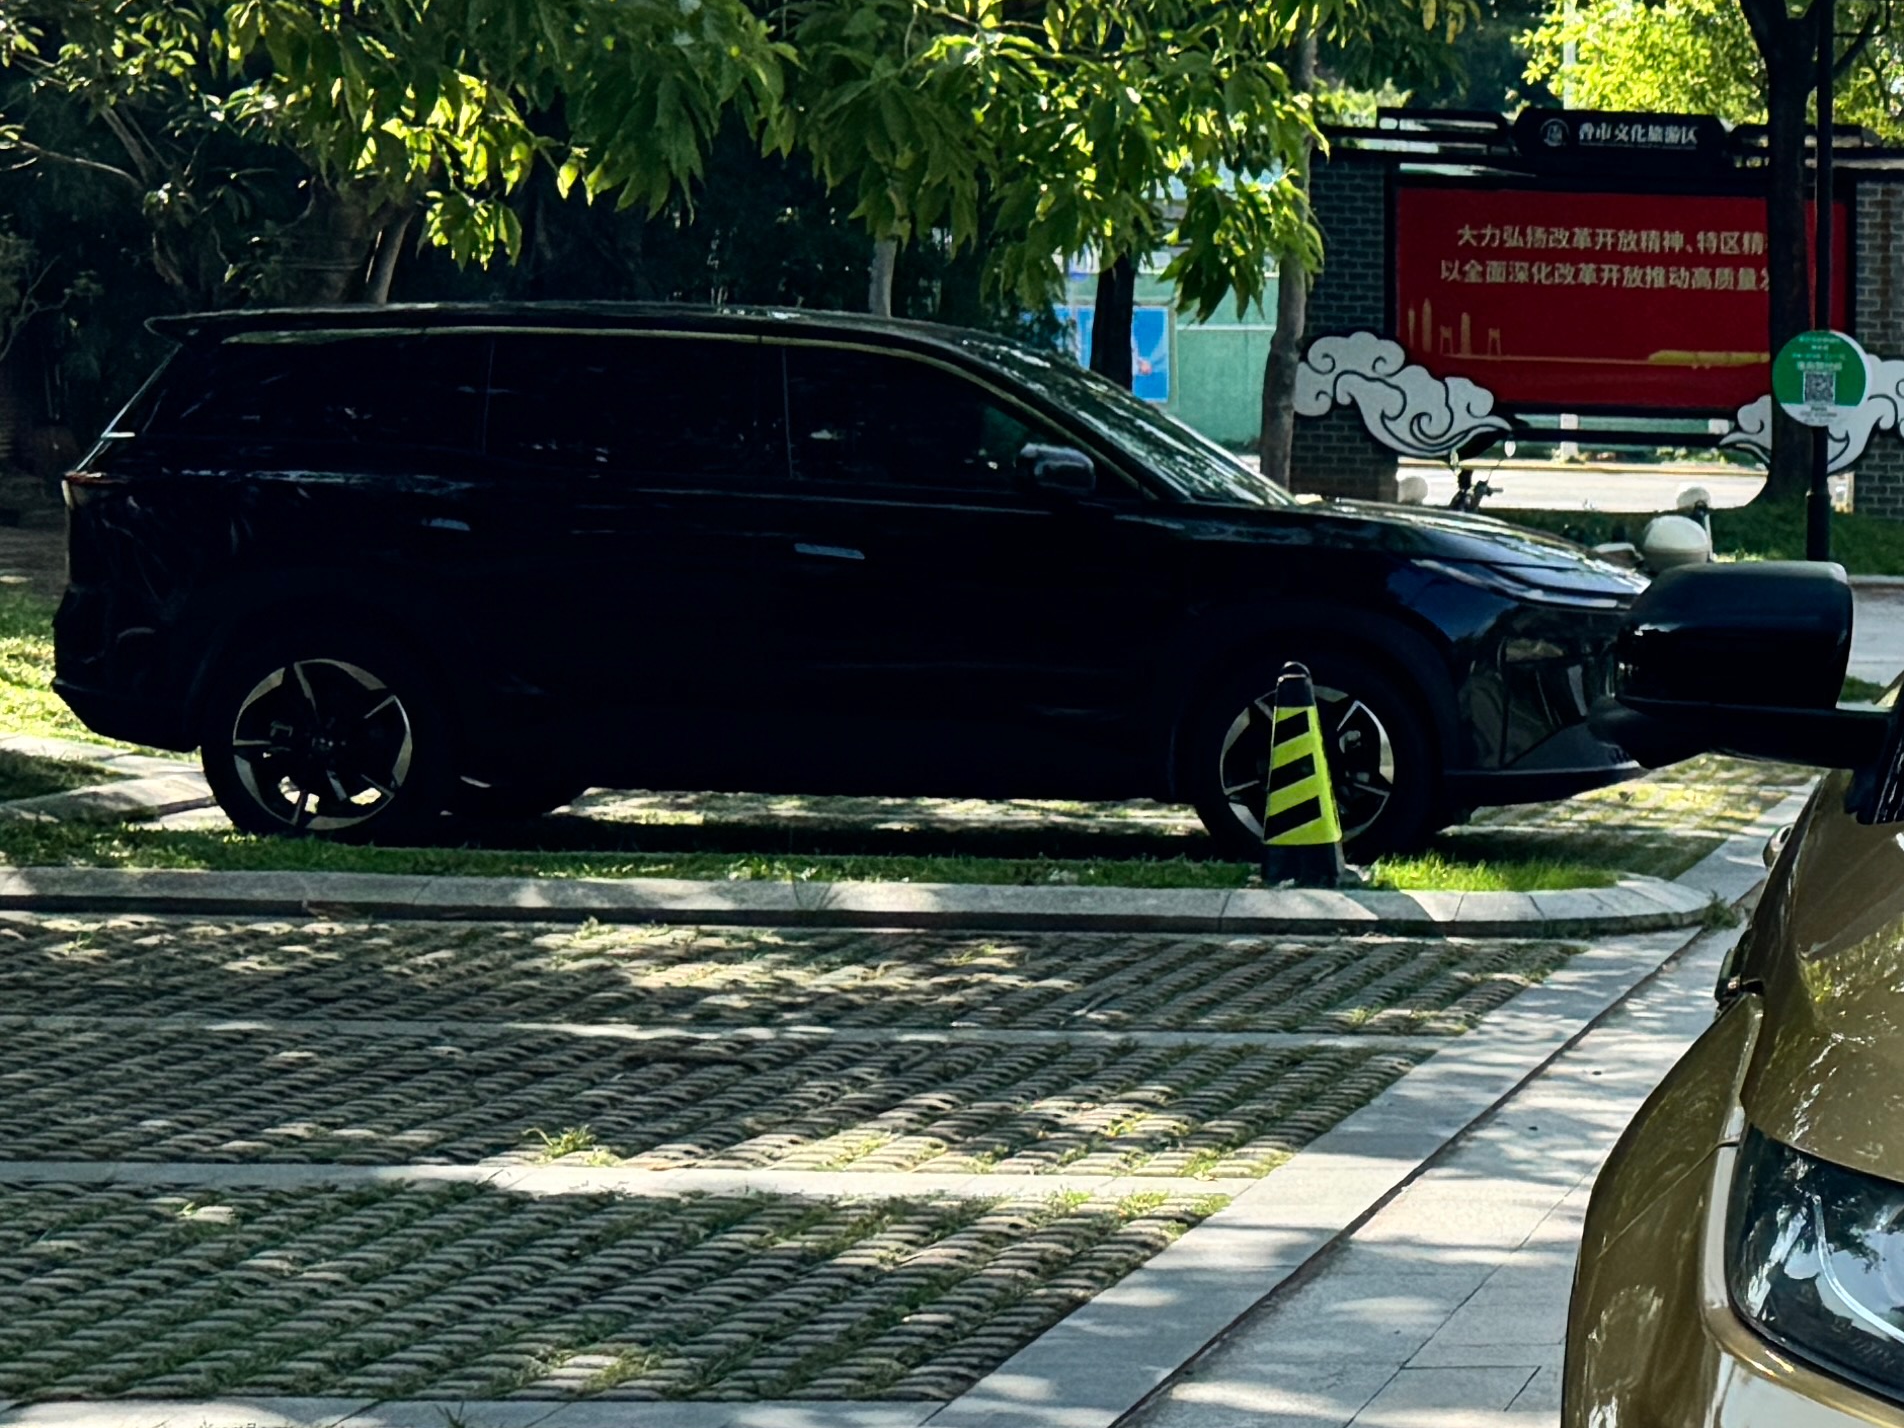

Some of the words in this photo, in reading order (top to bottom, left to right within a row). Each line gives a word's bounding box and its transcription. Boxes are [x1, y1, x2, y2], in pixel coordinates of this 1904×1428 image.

[1456, 224, 1768, 256] 大力弘扬改革开放精神、特区精
